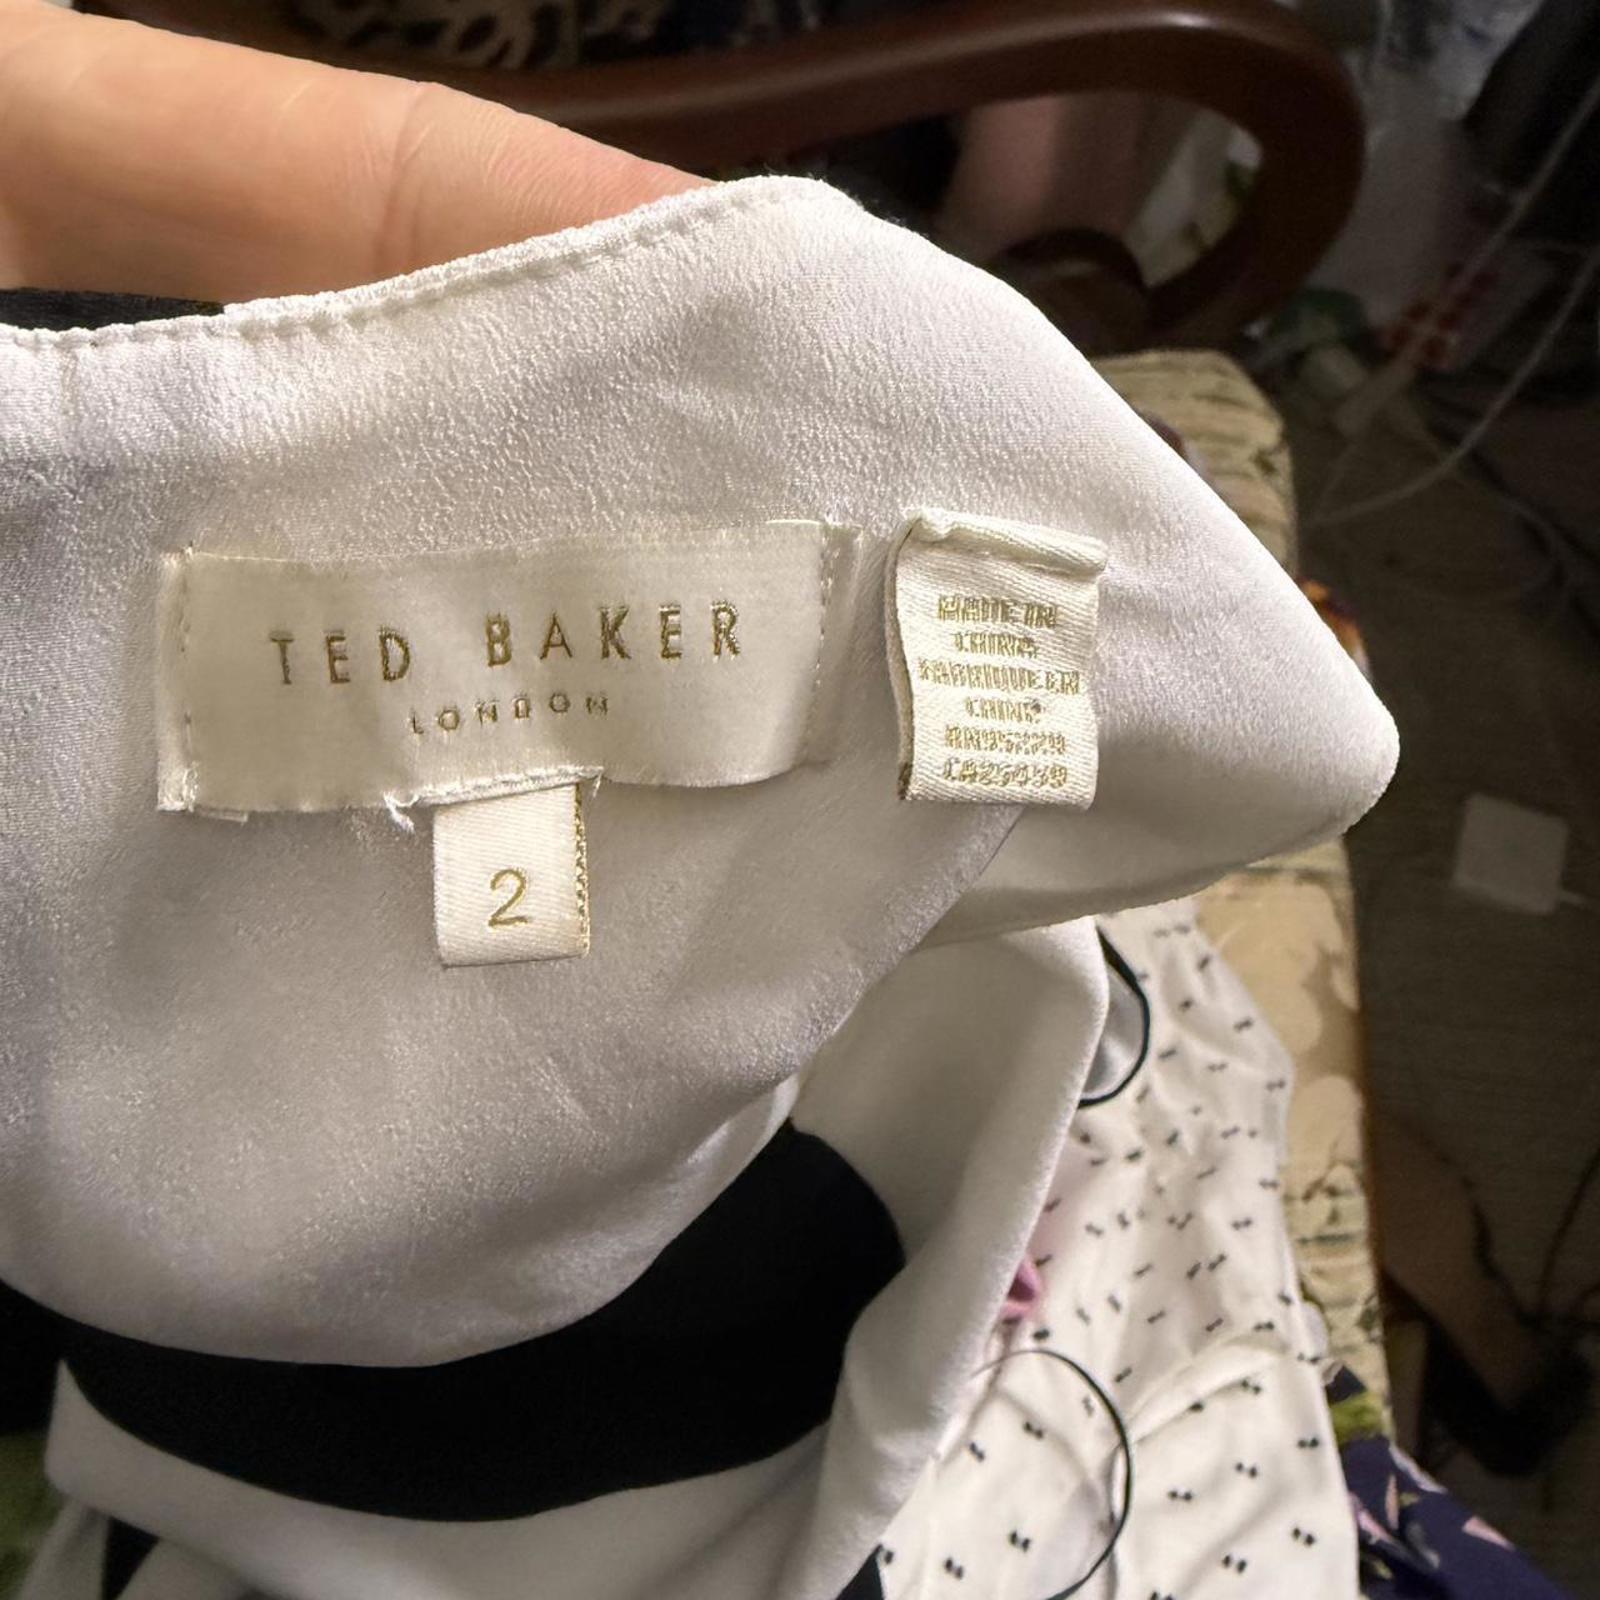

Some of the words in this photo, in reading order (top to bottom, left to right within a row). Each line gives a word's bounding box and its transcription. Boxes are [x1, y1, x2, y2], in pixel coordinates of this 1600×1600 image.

[939, 596, 1018, 624] MADE
[1023, 602, 1058, 627] IN
[270, 627, 410, 685] TED
[485, 601, 740, 667] BAKER
[954, 632, 1038, 658] CHINA
[410, 692, 608, 734] LONDON
[488, 868, 528, 929] 2
